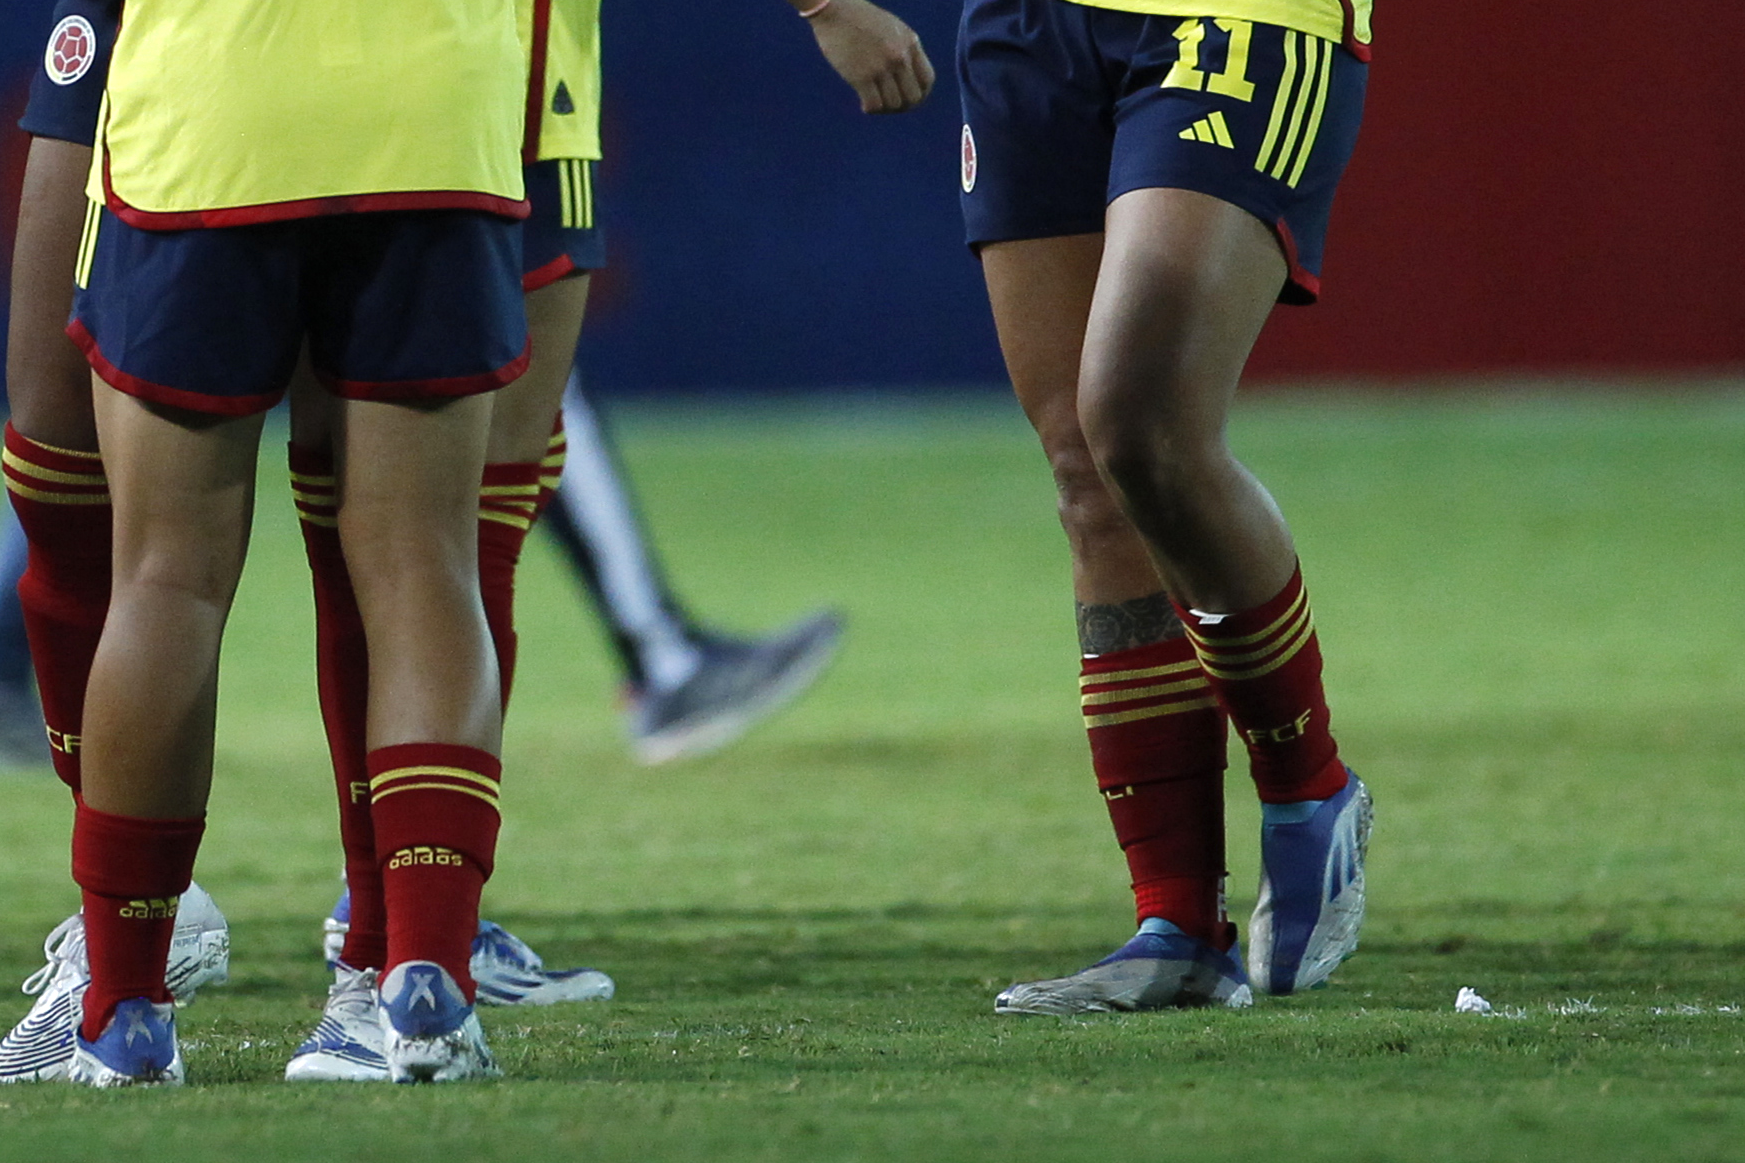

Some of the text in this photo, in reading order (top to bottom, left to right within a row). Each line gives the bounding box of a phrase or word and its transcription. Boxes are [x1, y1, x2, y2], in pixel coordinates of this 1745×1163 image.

[1160, 18, 1256, 103] 11
[1246, 708, 1312, 745] FCF
[389, 846, 463, 870] adidas
